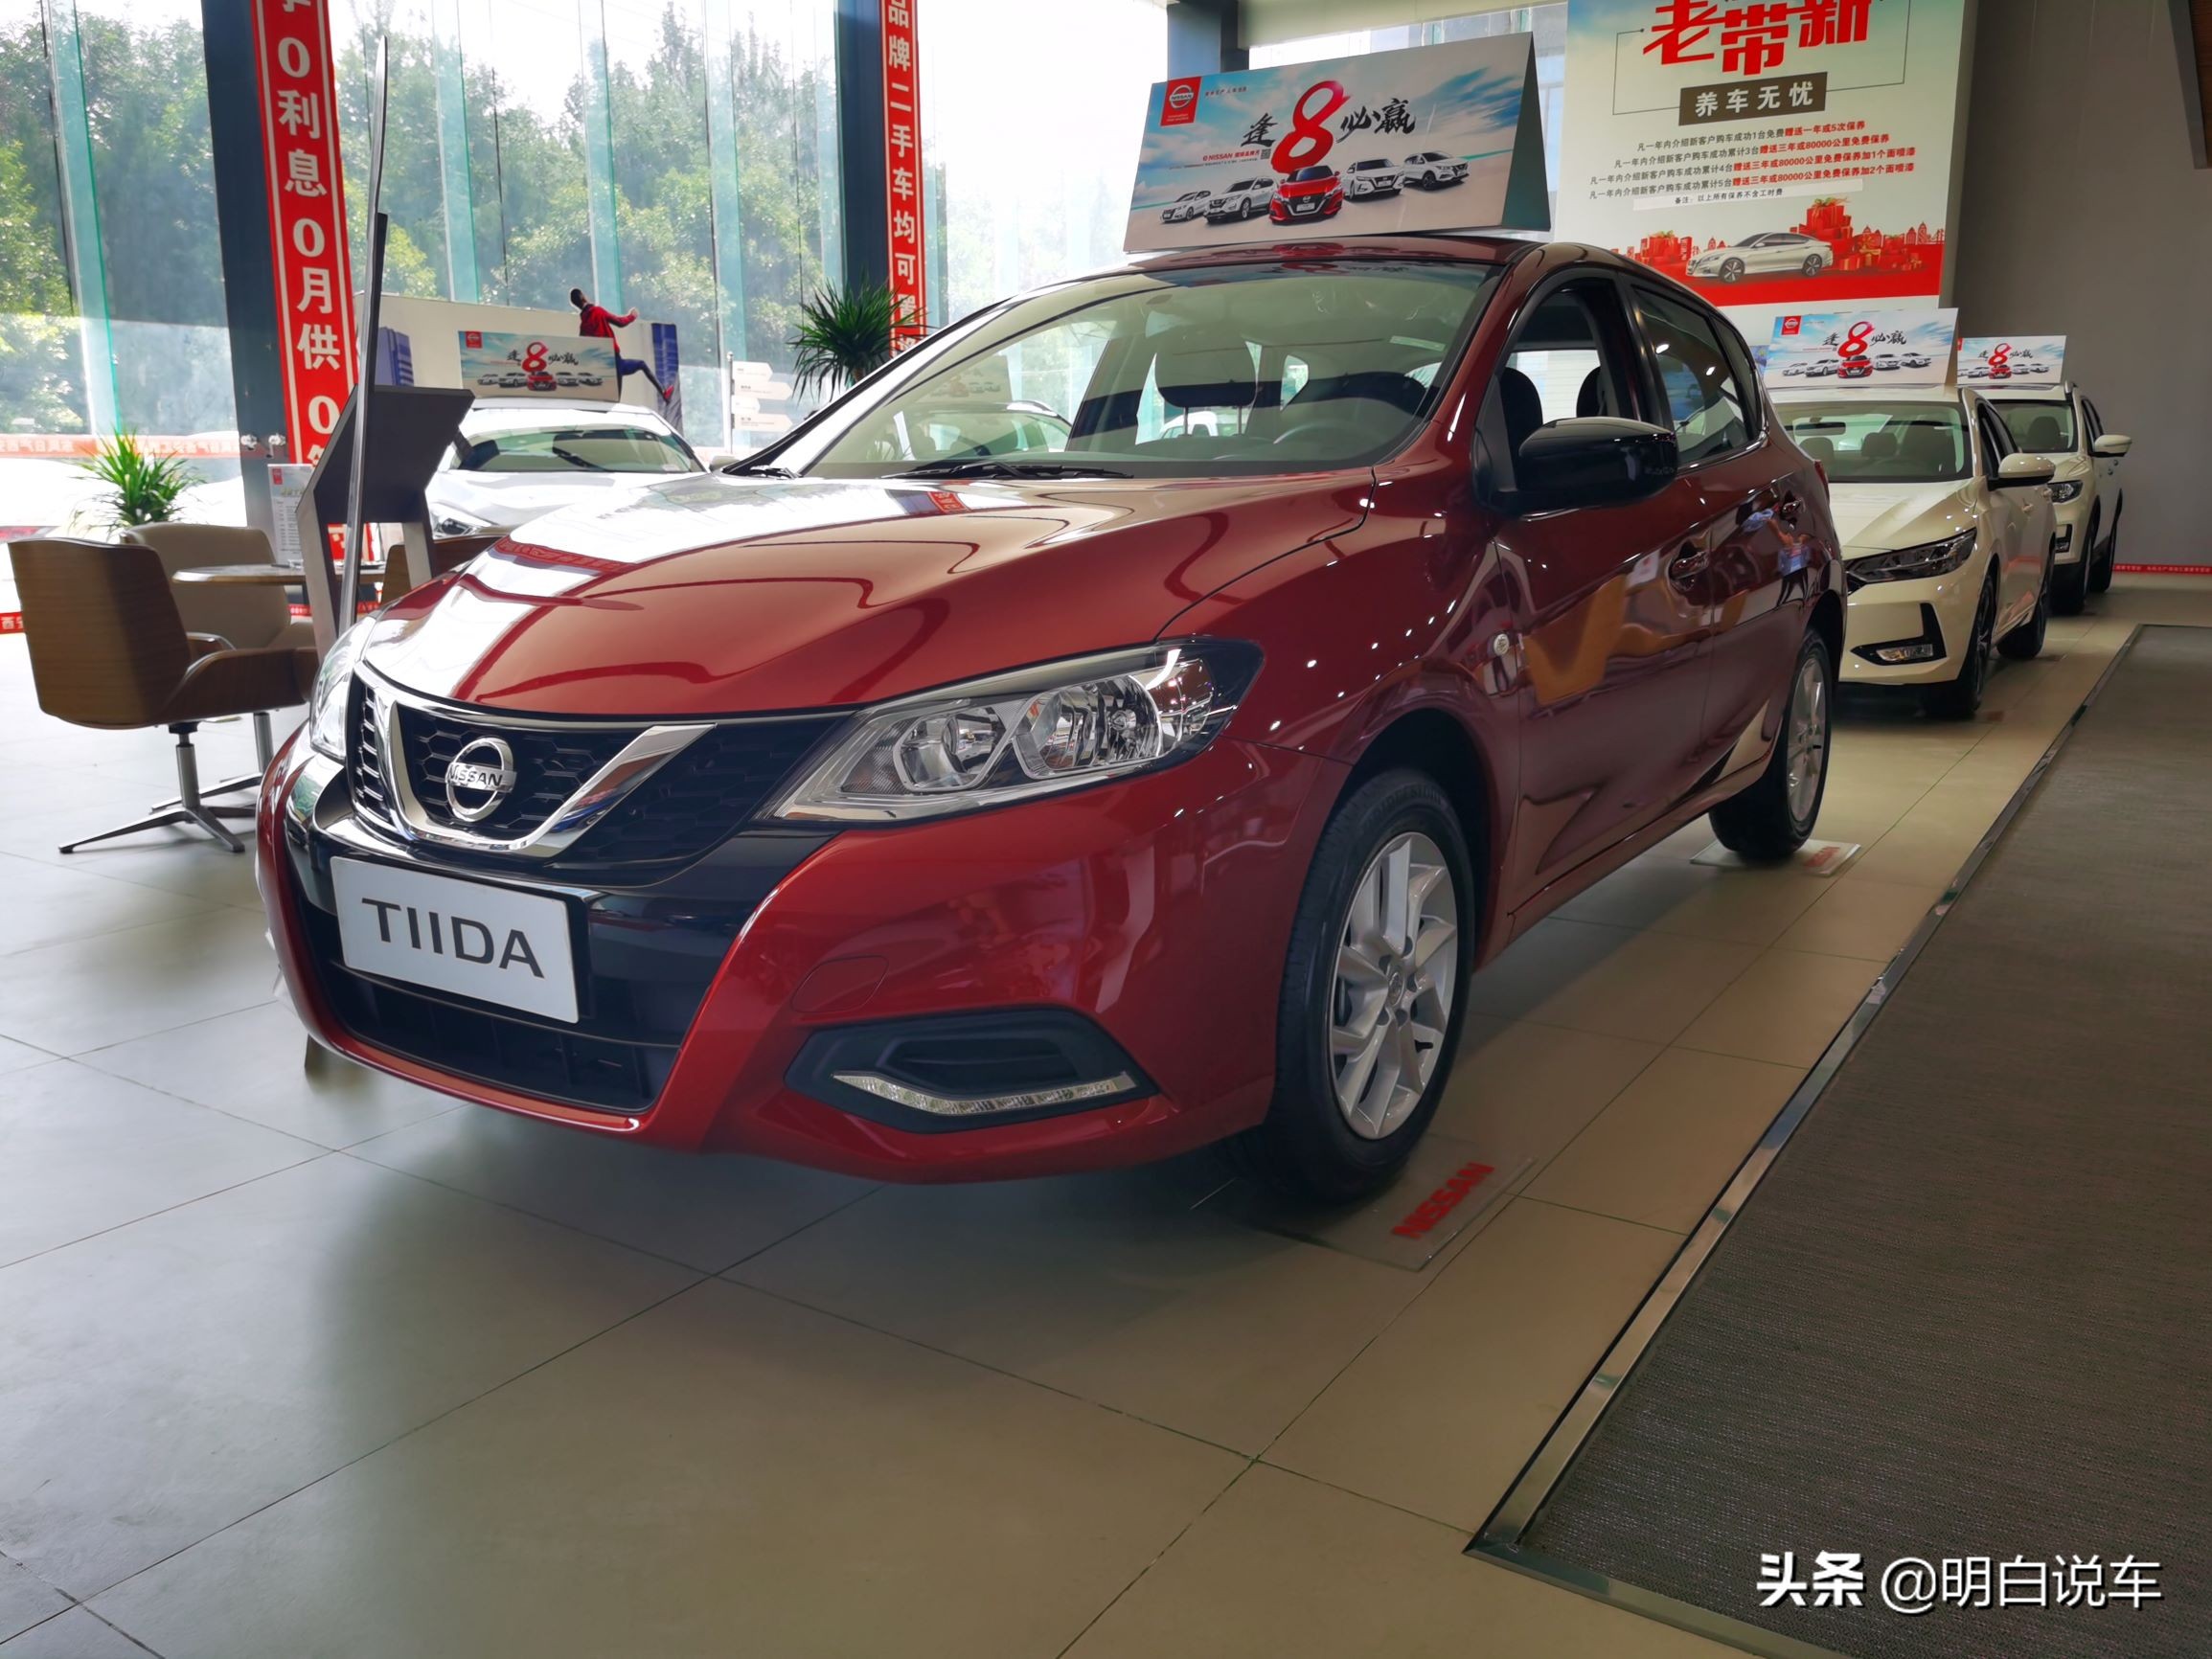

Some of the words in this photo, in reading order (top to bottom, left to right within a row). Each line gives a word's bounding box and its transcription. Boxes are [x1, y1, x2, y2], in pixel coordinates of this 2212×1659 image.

[1643, 0, 1873, 76] 老带新
[1695, 81, 1813, 117] 养车无忧
[447, 761, 503, 787] NISSAN
[361, 897, 545, 979] TIIDA
[1392, 1161, 1495, 1239] NISSAN
